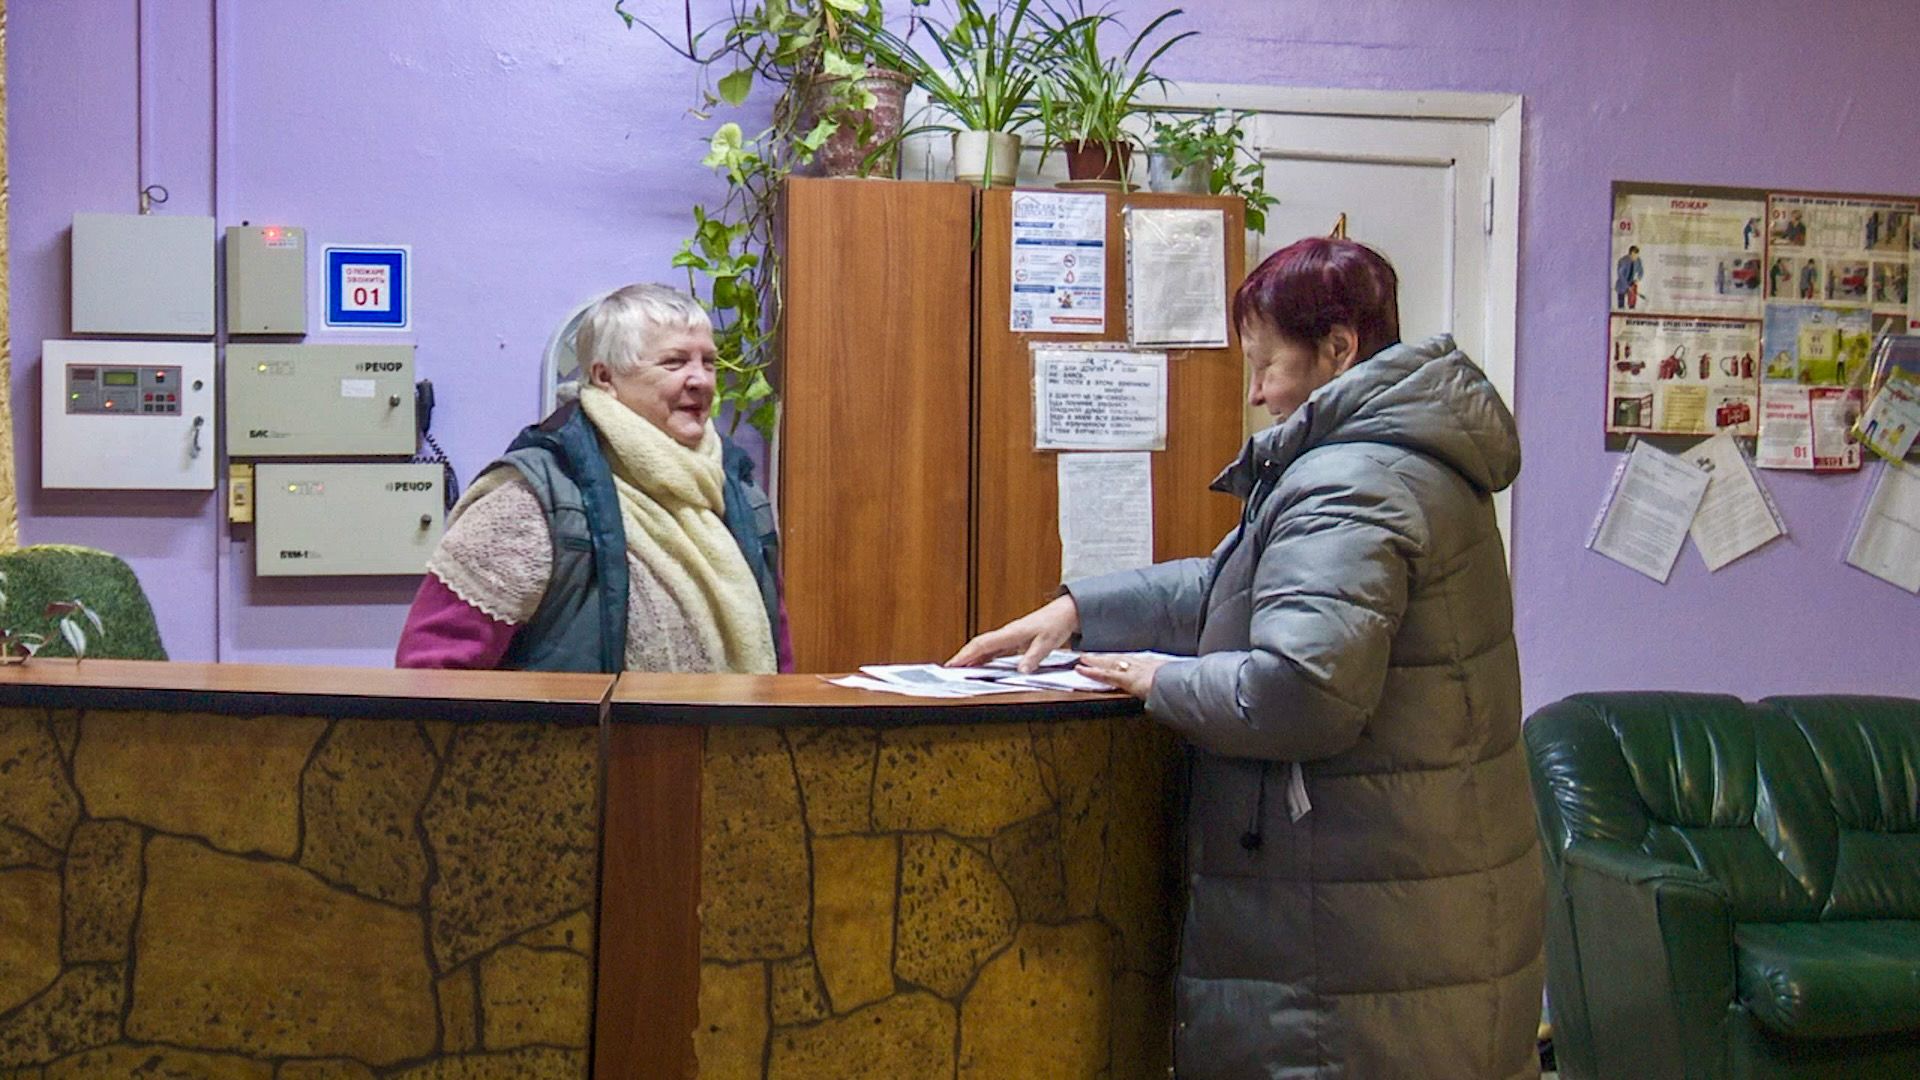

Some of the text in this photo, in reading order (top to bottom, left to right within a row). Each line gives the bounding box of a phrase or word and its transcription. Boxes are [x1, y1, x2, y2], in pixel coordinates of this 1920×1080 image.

[1671, 200, 1709, 209] ПОЖАР
[1619, 221, 1632, 231] 01
[353, 267, 385, 275] ПОЖАРЕ
[353, 287, 379, 306] 01
[365, 362, 403, 372] РЕЧОР
[1794, 446, 1807, 458] 01
[394, 482, 432, 491] РЕЧОР
